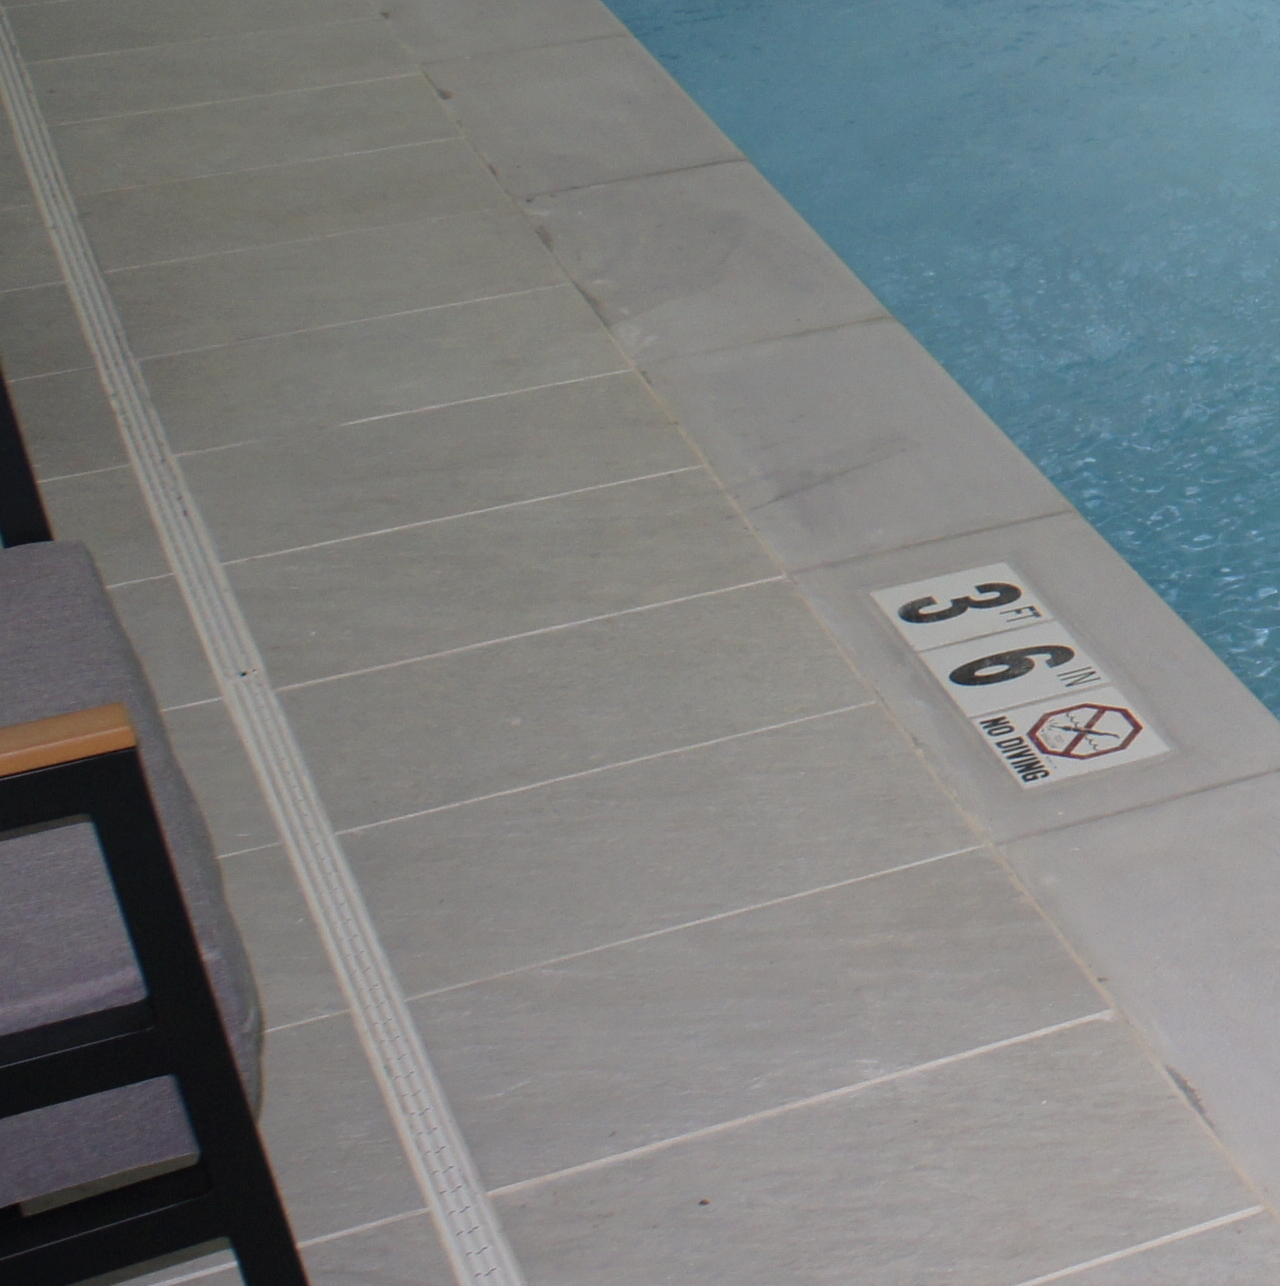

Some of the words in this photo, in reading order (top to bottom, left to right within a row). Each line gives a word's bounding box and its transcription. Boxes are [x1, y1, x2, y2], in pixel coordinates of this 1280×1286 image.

[897, 582, 1022, 624] 3
[999, 605, 1042, 623] FT
[949, 645, 1075, 686] 6
[1057, 666, 1101, 688] IN
[979, 715, 1016, 737] NO
[995, 736, 1050, 783] DIVING
